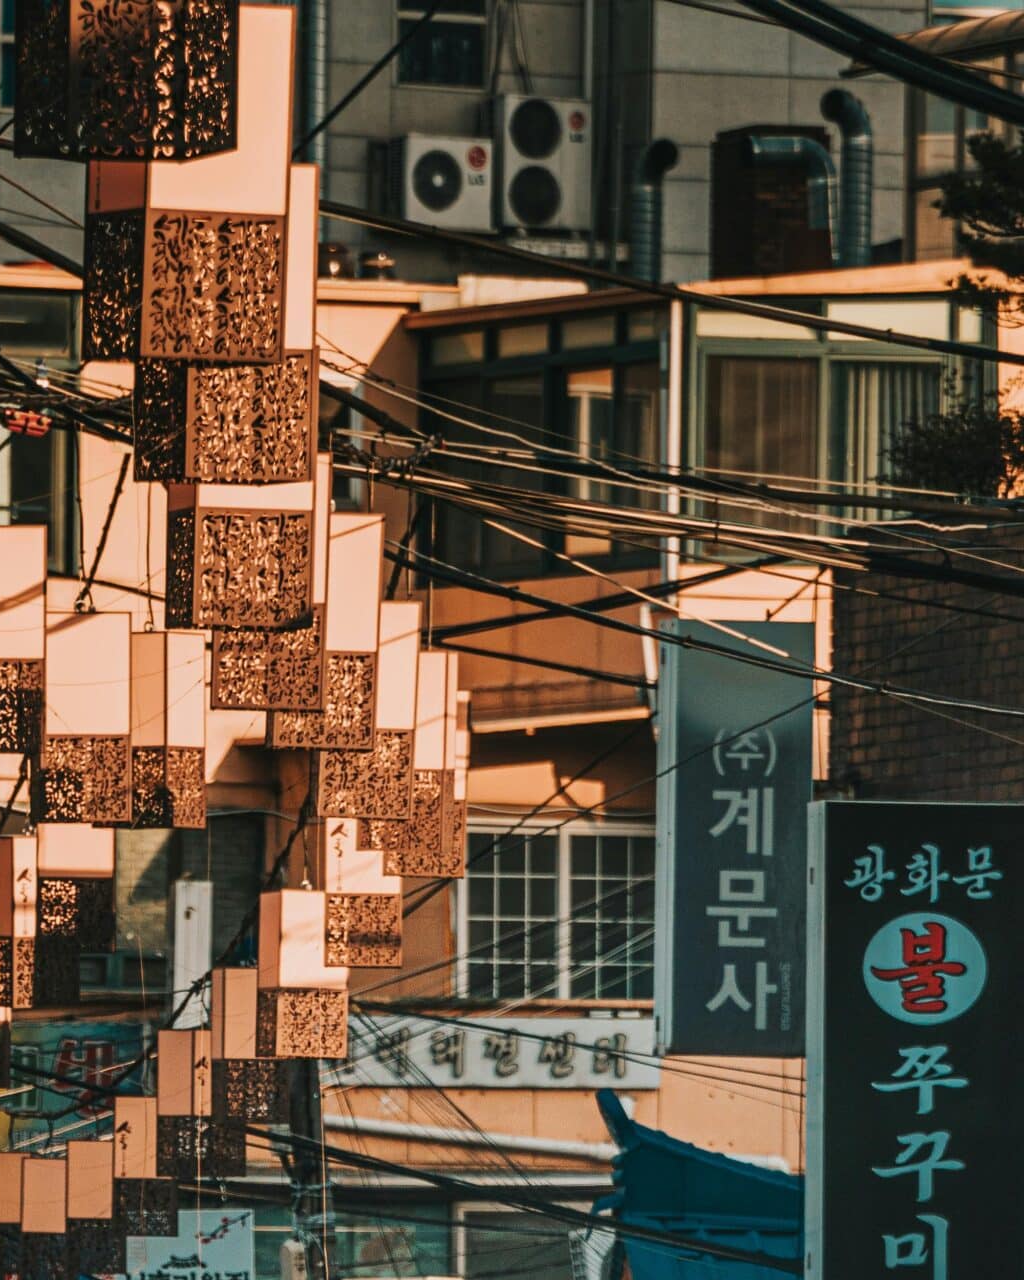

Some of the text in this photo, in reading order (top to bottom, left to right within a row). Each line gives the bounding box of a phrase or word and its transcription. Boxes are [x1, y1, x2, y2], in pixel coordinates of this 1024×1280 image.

[705, 787, 778, 1031] 계문사
[844, 844, 1003, 903] 광화문
[870, 921, 967, 1014] 불
